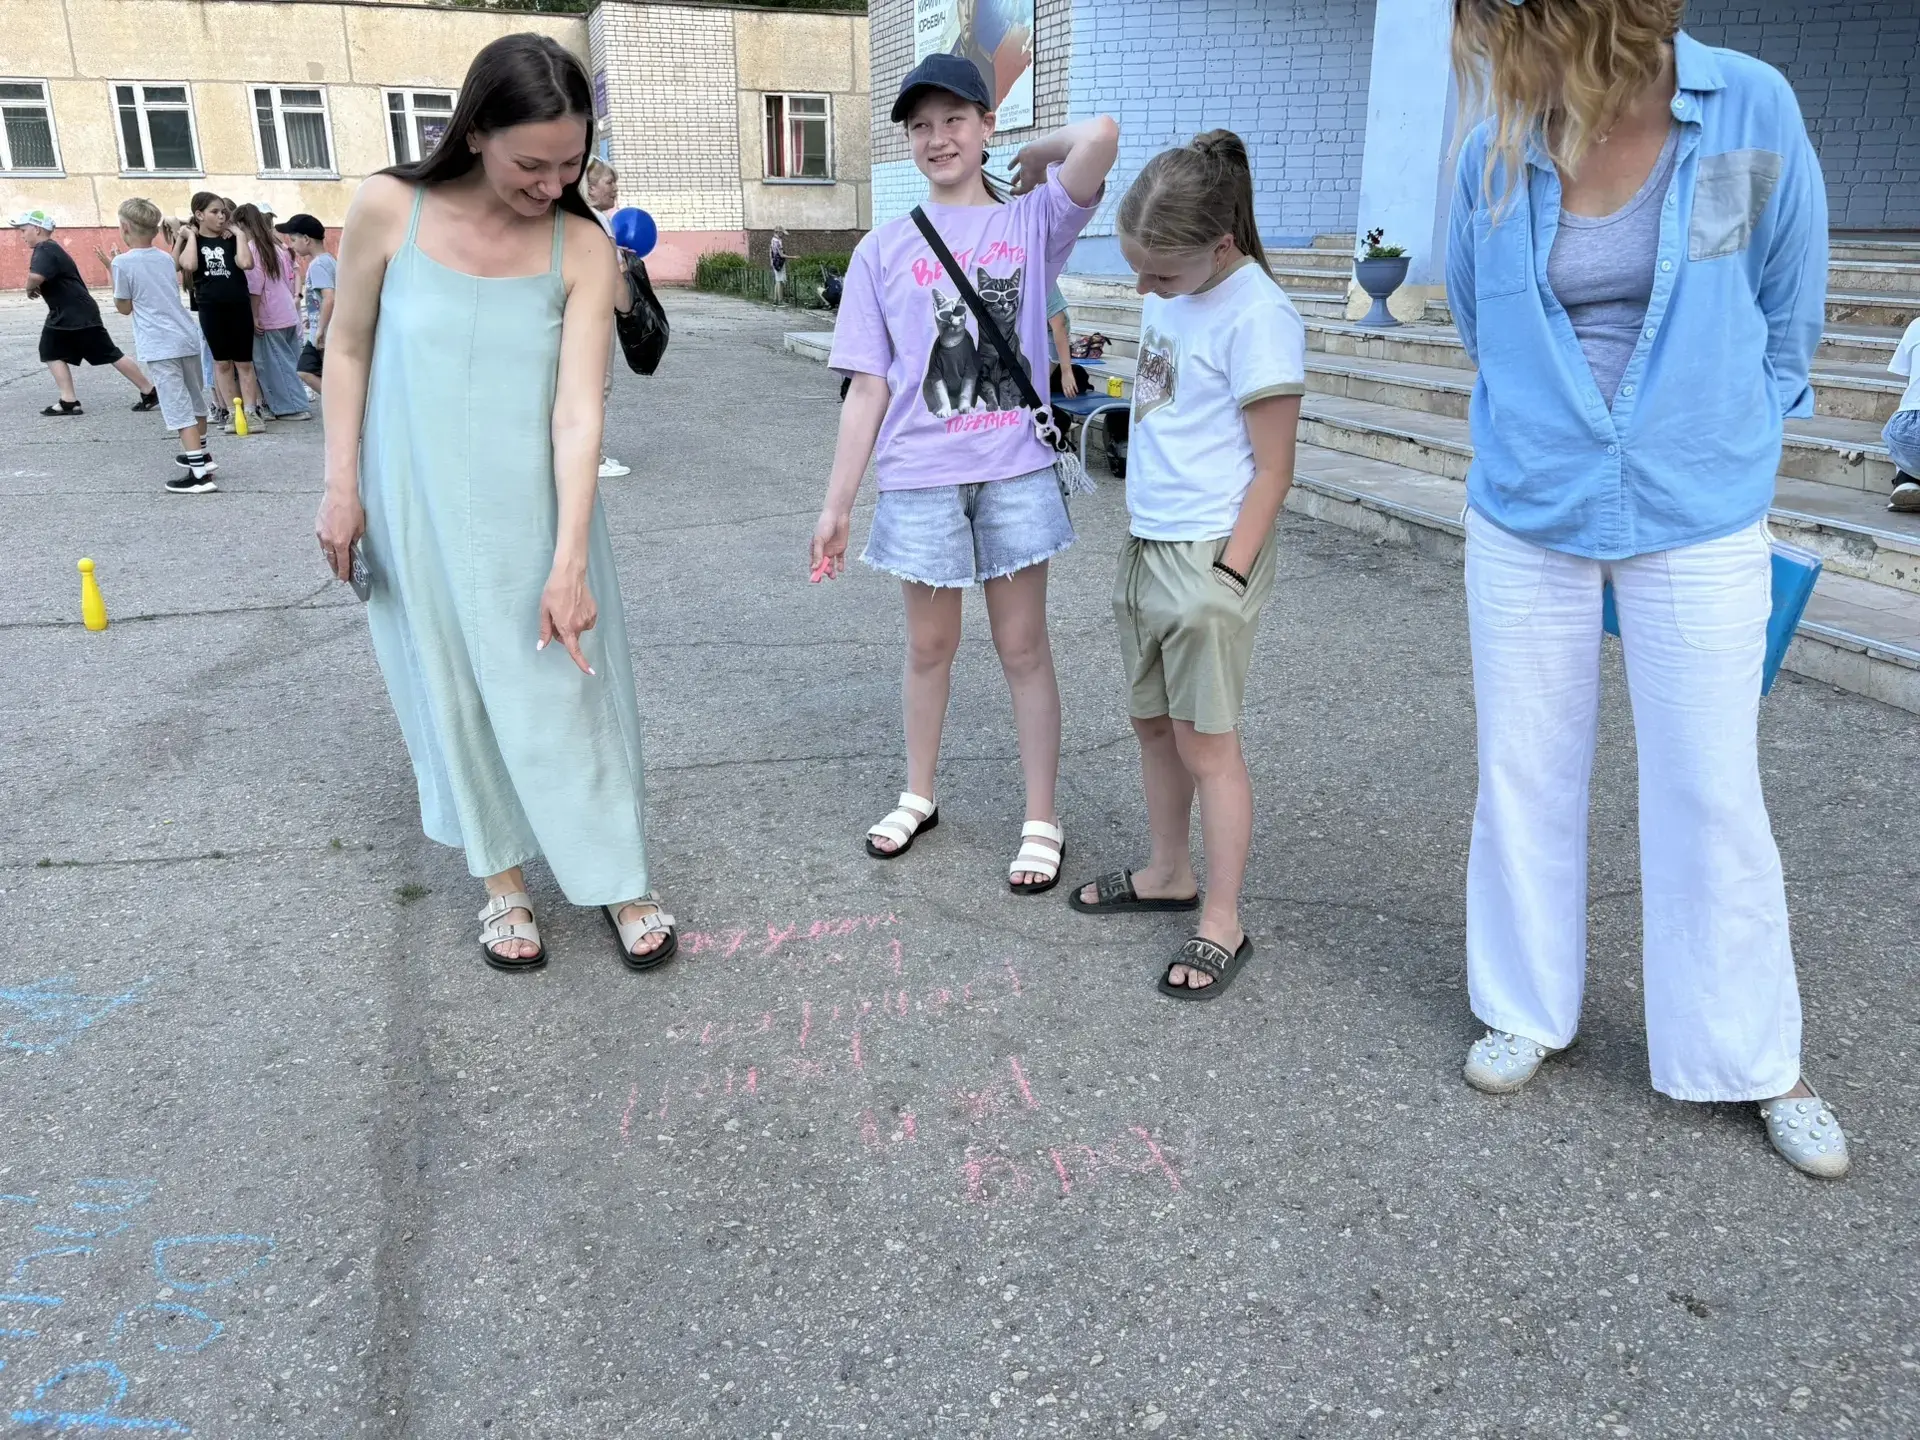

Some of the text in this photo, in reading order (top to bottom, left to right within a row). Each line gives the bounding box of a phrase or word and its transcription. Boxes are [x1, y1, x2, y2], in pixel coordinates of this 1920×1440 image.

[918, 11, 947, 33] ЮРЬЕВИЧ
[911, 248, 974, 287] BET
[944, 410, 1022, 435] TOGETHER
